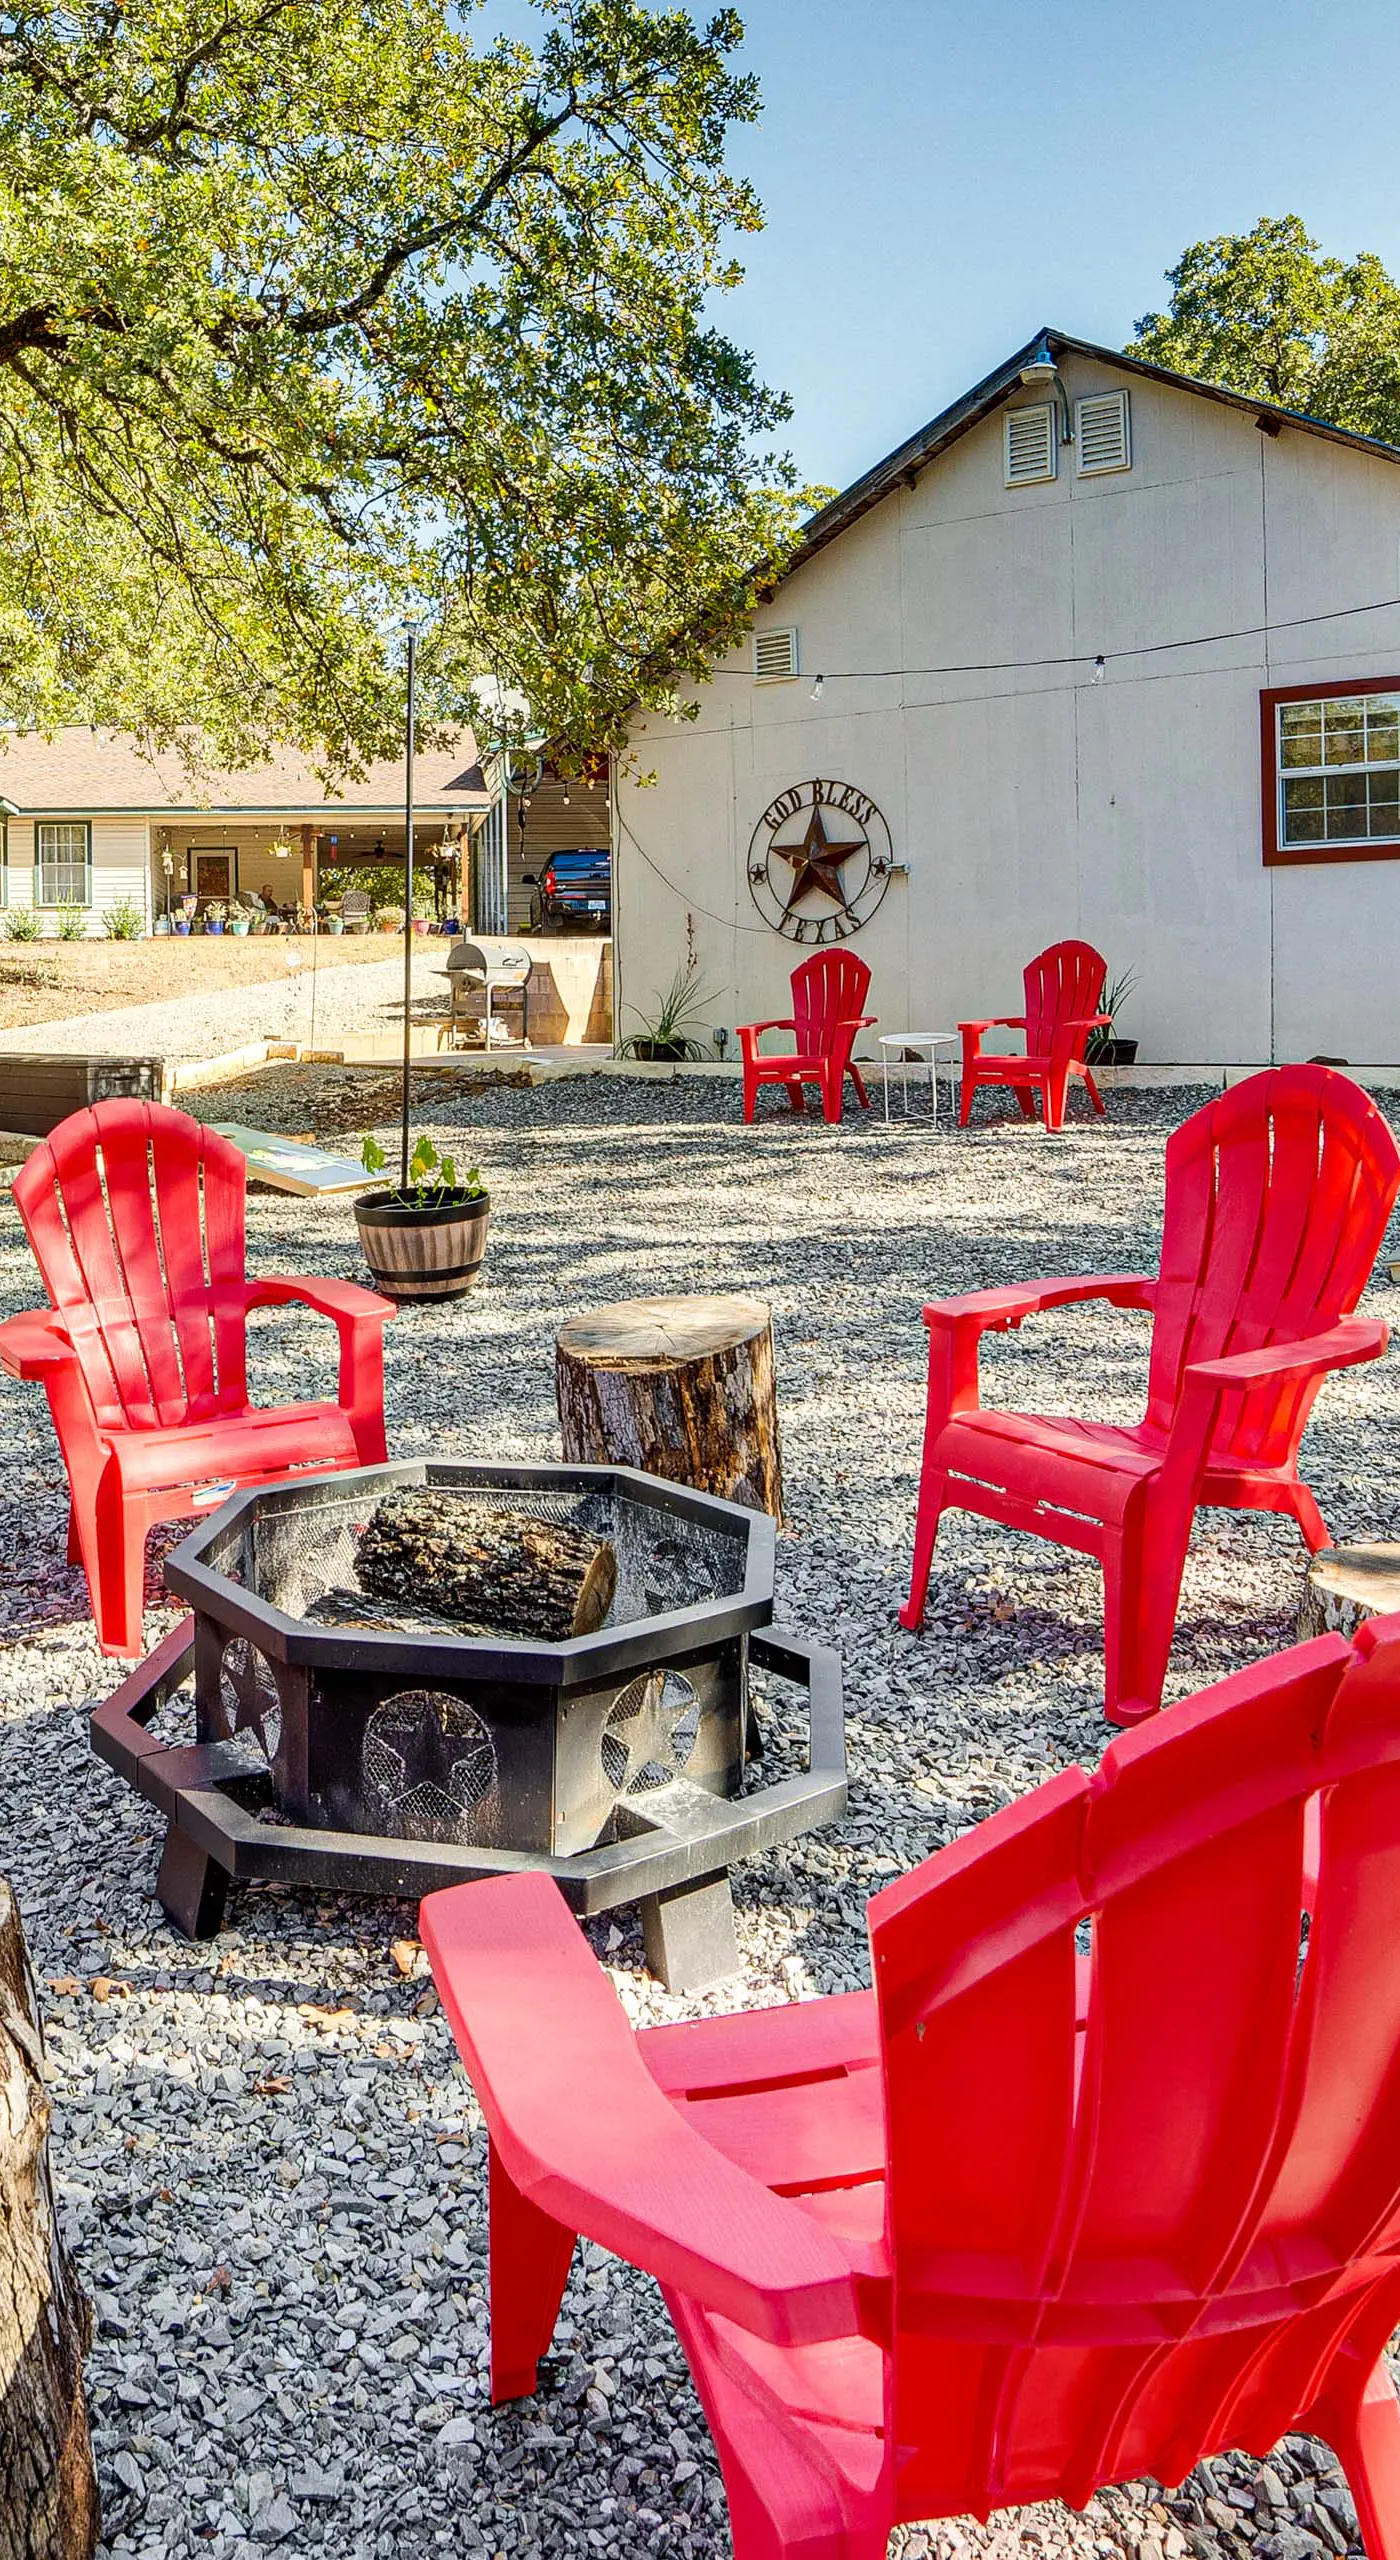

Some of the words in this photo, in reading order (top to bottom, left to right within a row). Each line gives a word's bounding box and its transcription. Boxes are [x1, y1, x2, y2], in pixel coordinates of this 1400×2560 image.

[764, 789, 802, 830] GOD
[812, 780, 877, 825] BLESS
[777, 906, 862, 943] TEXAS
